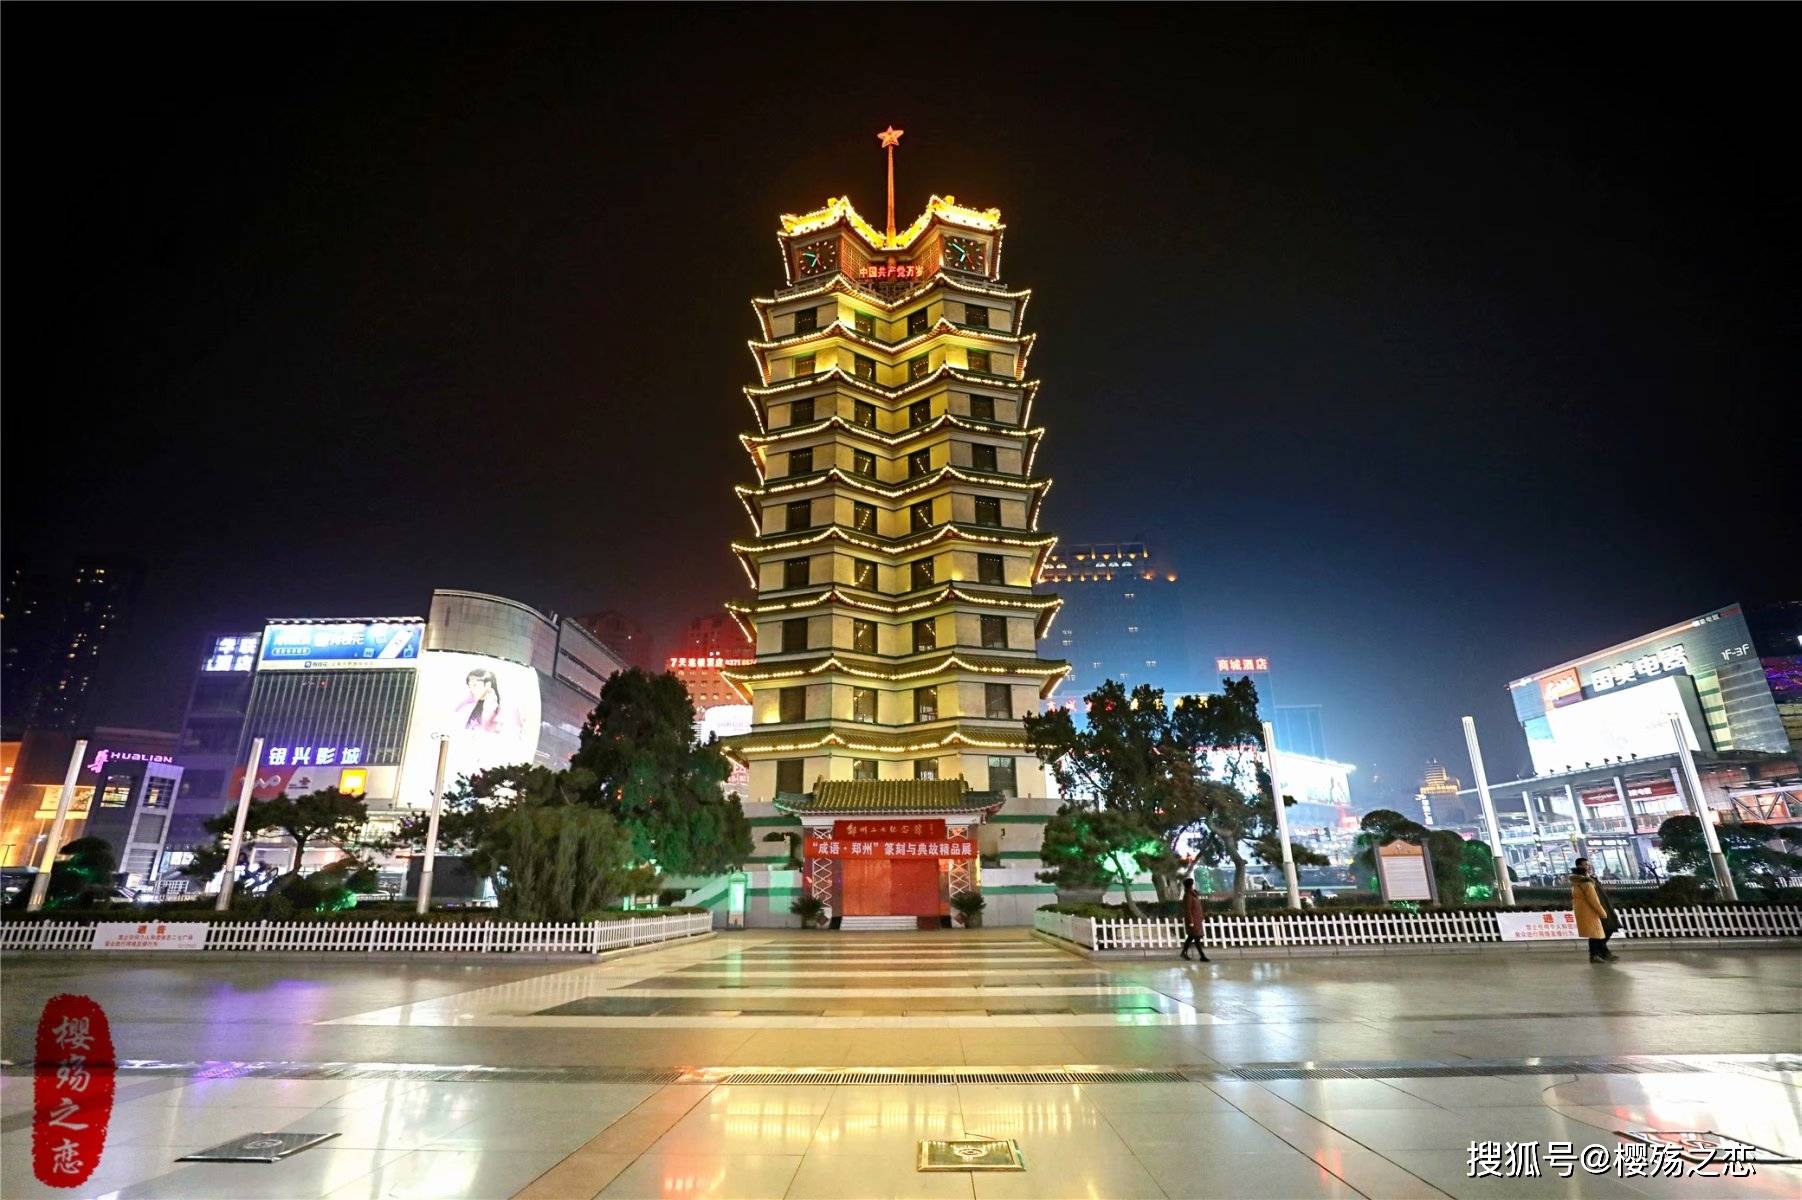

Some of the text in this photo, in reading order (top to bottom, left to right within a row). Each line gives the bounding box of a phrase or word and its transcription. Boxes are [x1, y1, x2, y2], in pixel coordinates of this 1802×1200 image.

[860, 265, 924, 278] 中国共产党万岁
[1719, 643, 1751, 661] 1F-3F
[1217, 658, 1268, 672] 商城酒店
[1591, 644, 1689, 692] 国美电器
[269, 746, 361, 766] 银兴影城
[1542, 914, 1574, 923] 通告
